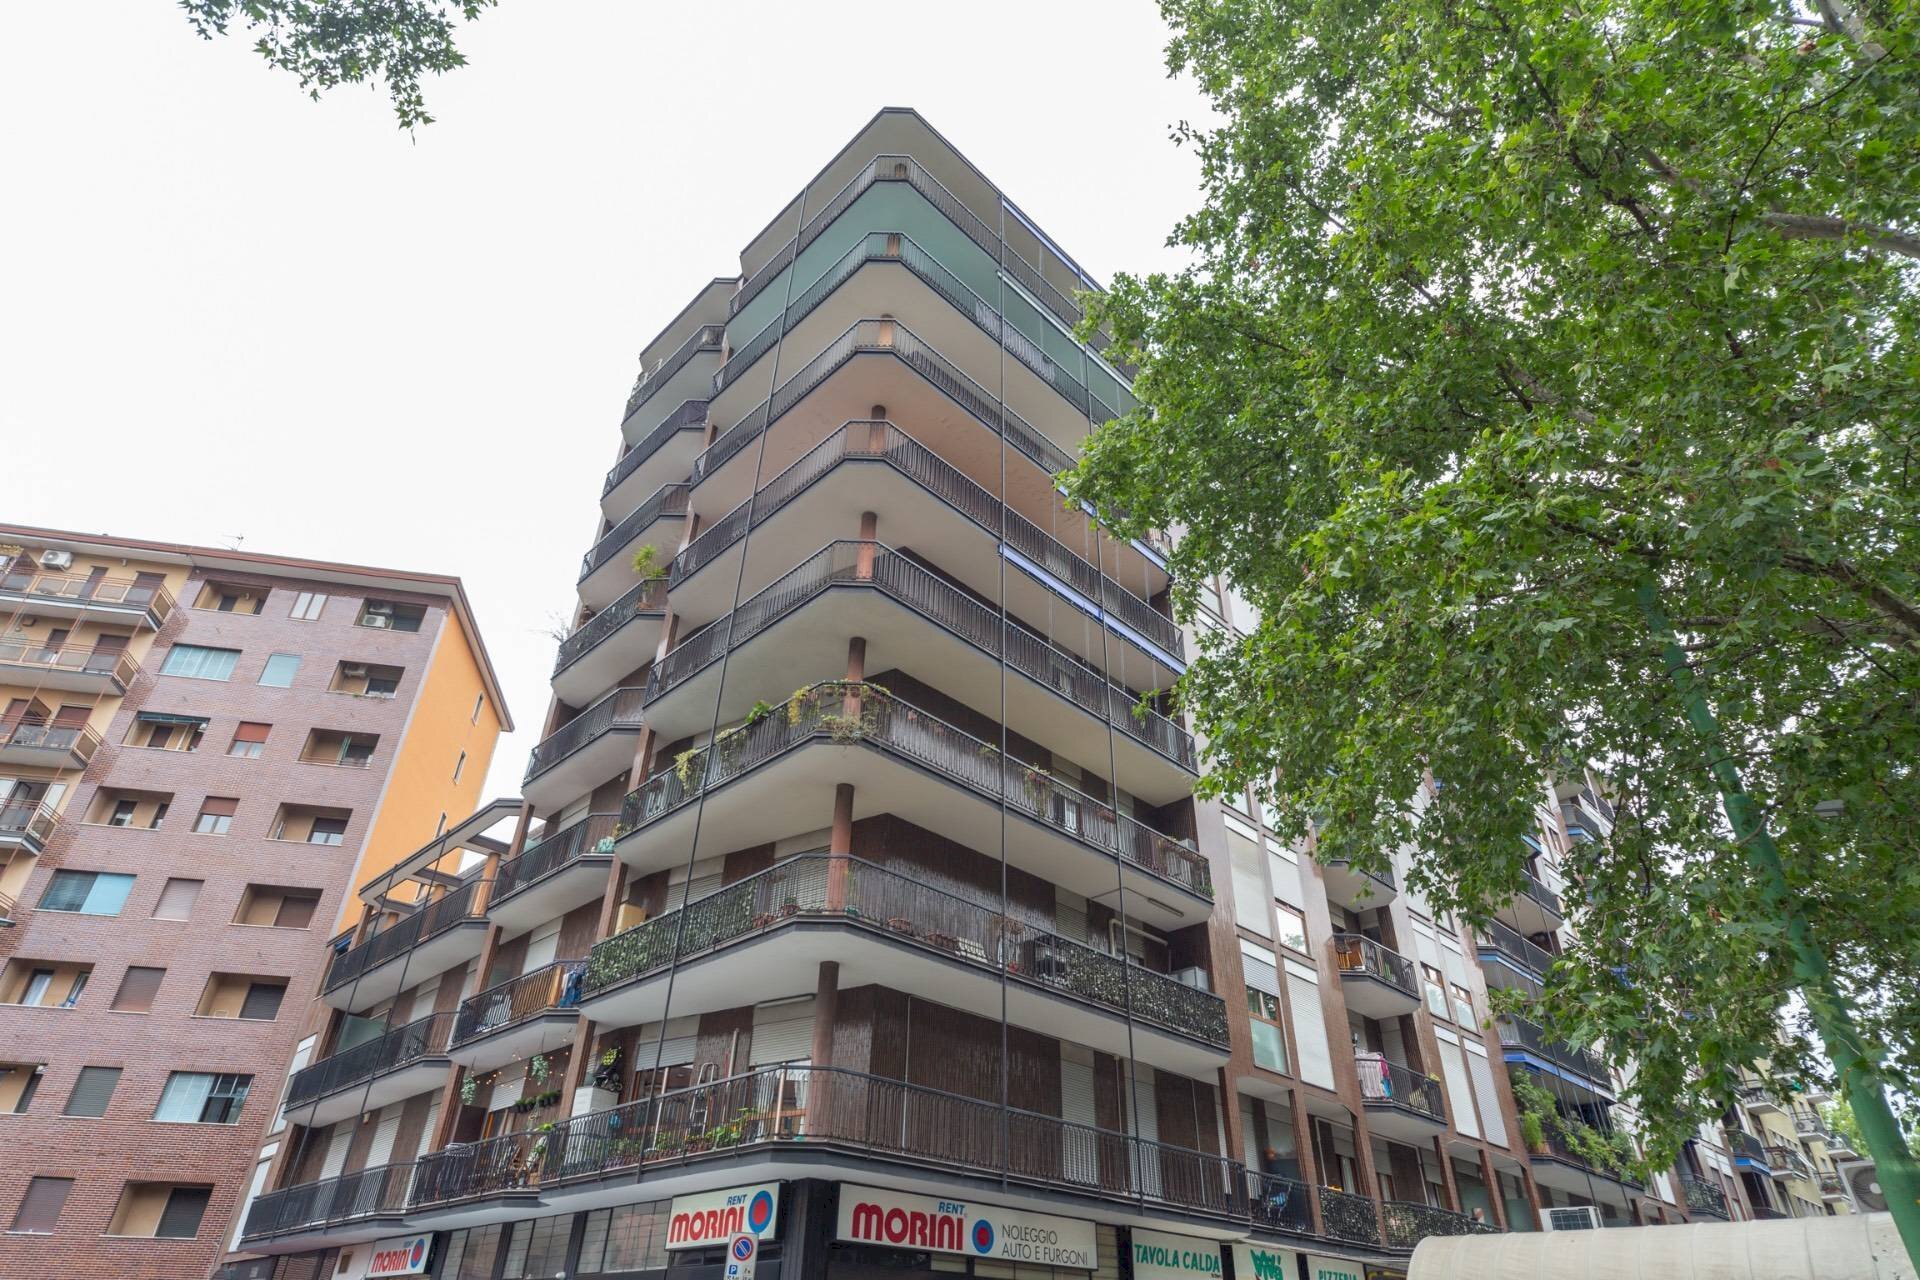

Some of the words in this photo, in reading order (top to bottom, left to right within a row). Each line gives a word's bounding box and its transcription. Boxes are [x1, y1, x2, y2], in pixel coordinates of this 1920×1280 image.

[727, 1194, 747, 1206] RENT
[938, 1201, 965, 1216] RENT
[669, 1206, 745, 1243] MORINI
[851, 1202, 964, 1251] MORINI
[1001, 1224, 1058, 1245] NOLEGGIO
[371, 1248, 411, 1273] MORINI
[1001, 1242, 1032, 1259] AUTO
[1035, 1246, 1041, 1260] E
[1043, 1247, 1088, 1265] FURGONI
[1134, 1244, 1180, 1268] TAVOLA
[1183, 1251, 1220, 1272] CALDA
